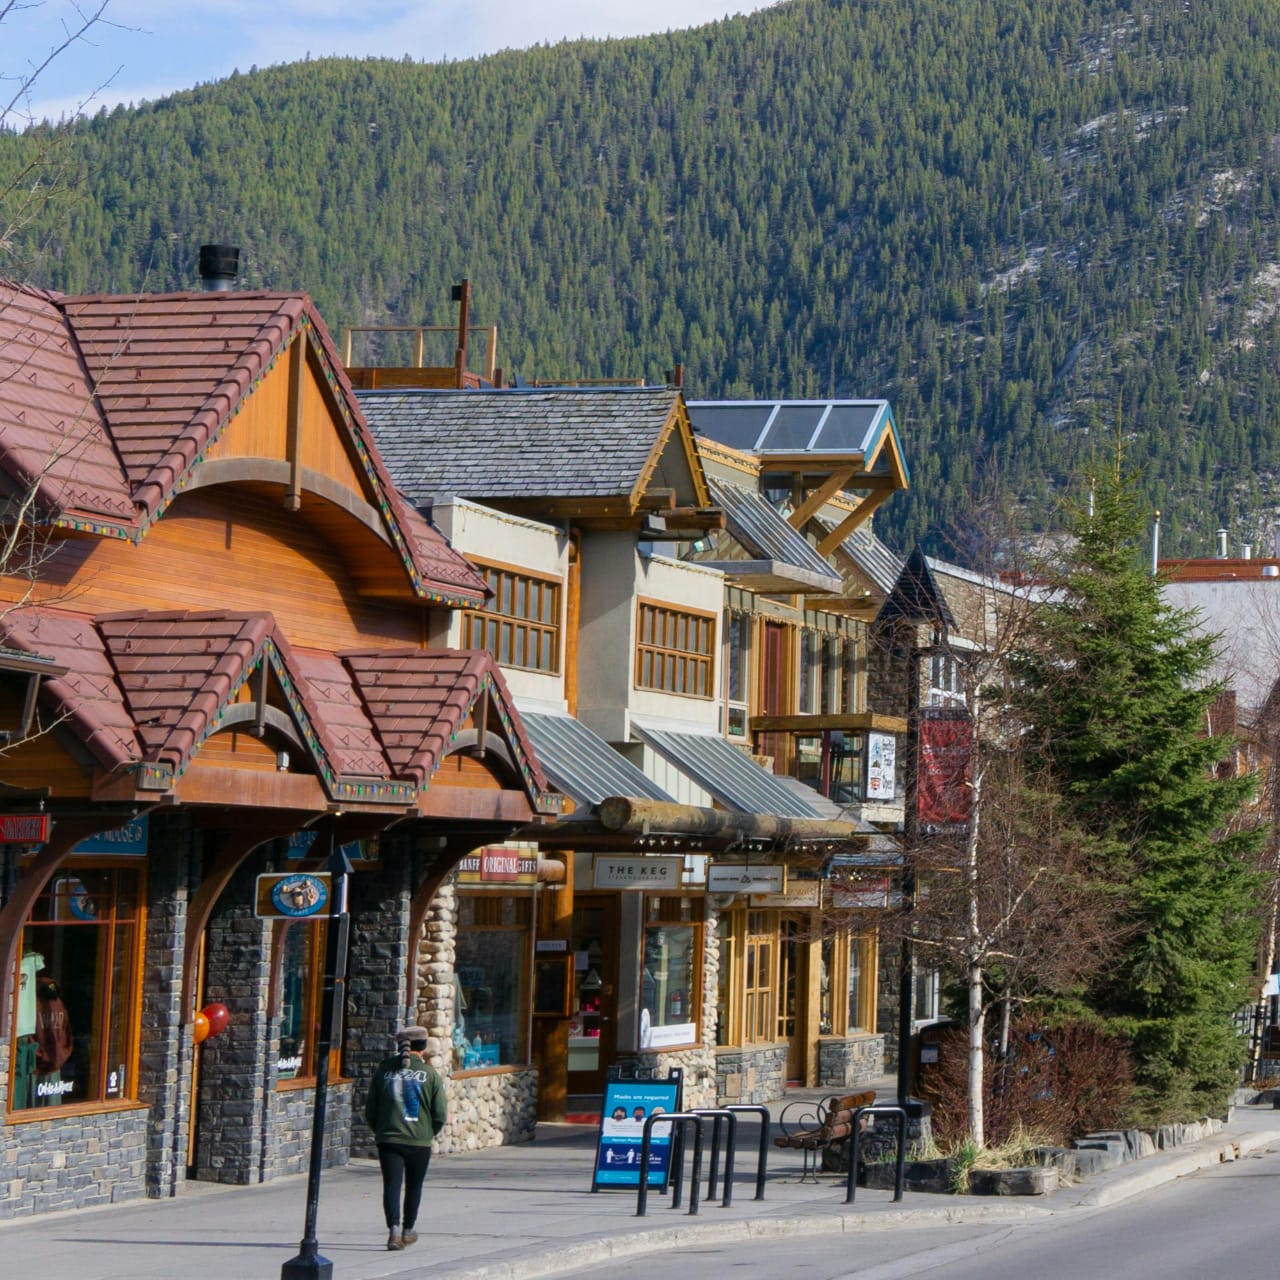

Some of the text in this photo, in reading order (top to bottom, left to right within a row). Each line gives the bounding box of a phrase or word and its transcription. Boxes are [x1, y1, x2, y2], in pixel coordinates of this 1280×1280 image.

[459, 856, 537, 873] BANFF ORIGINAL GIFTS
[608, 866, 667, 875] THE KEG
[644, 1094, 669, 1102] required
